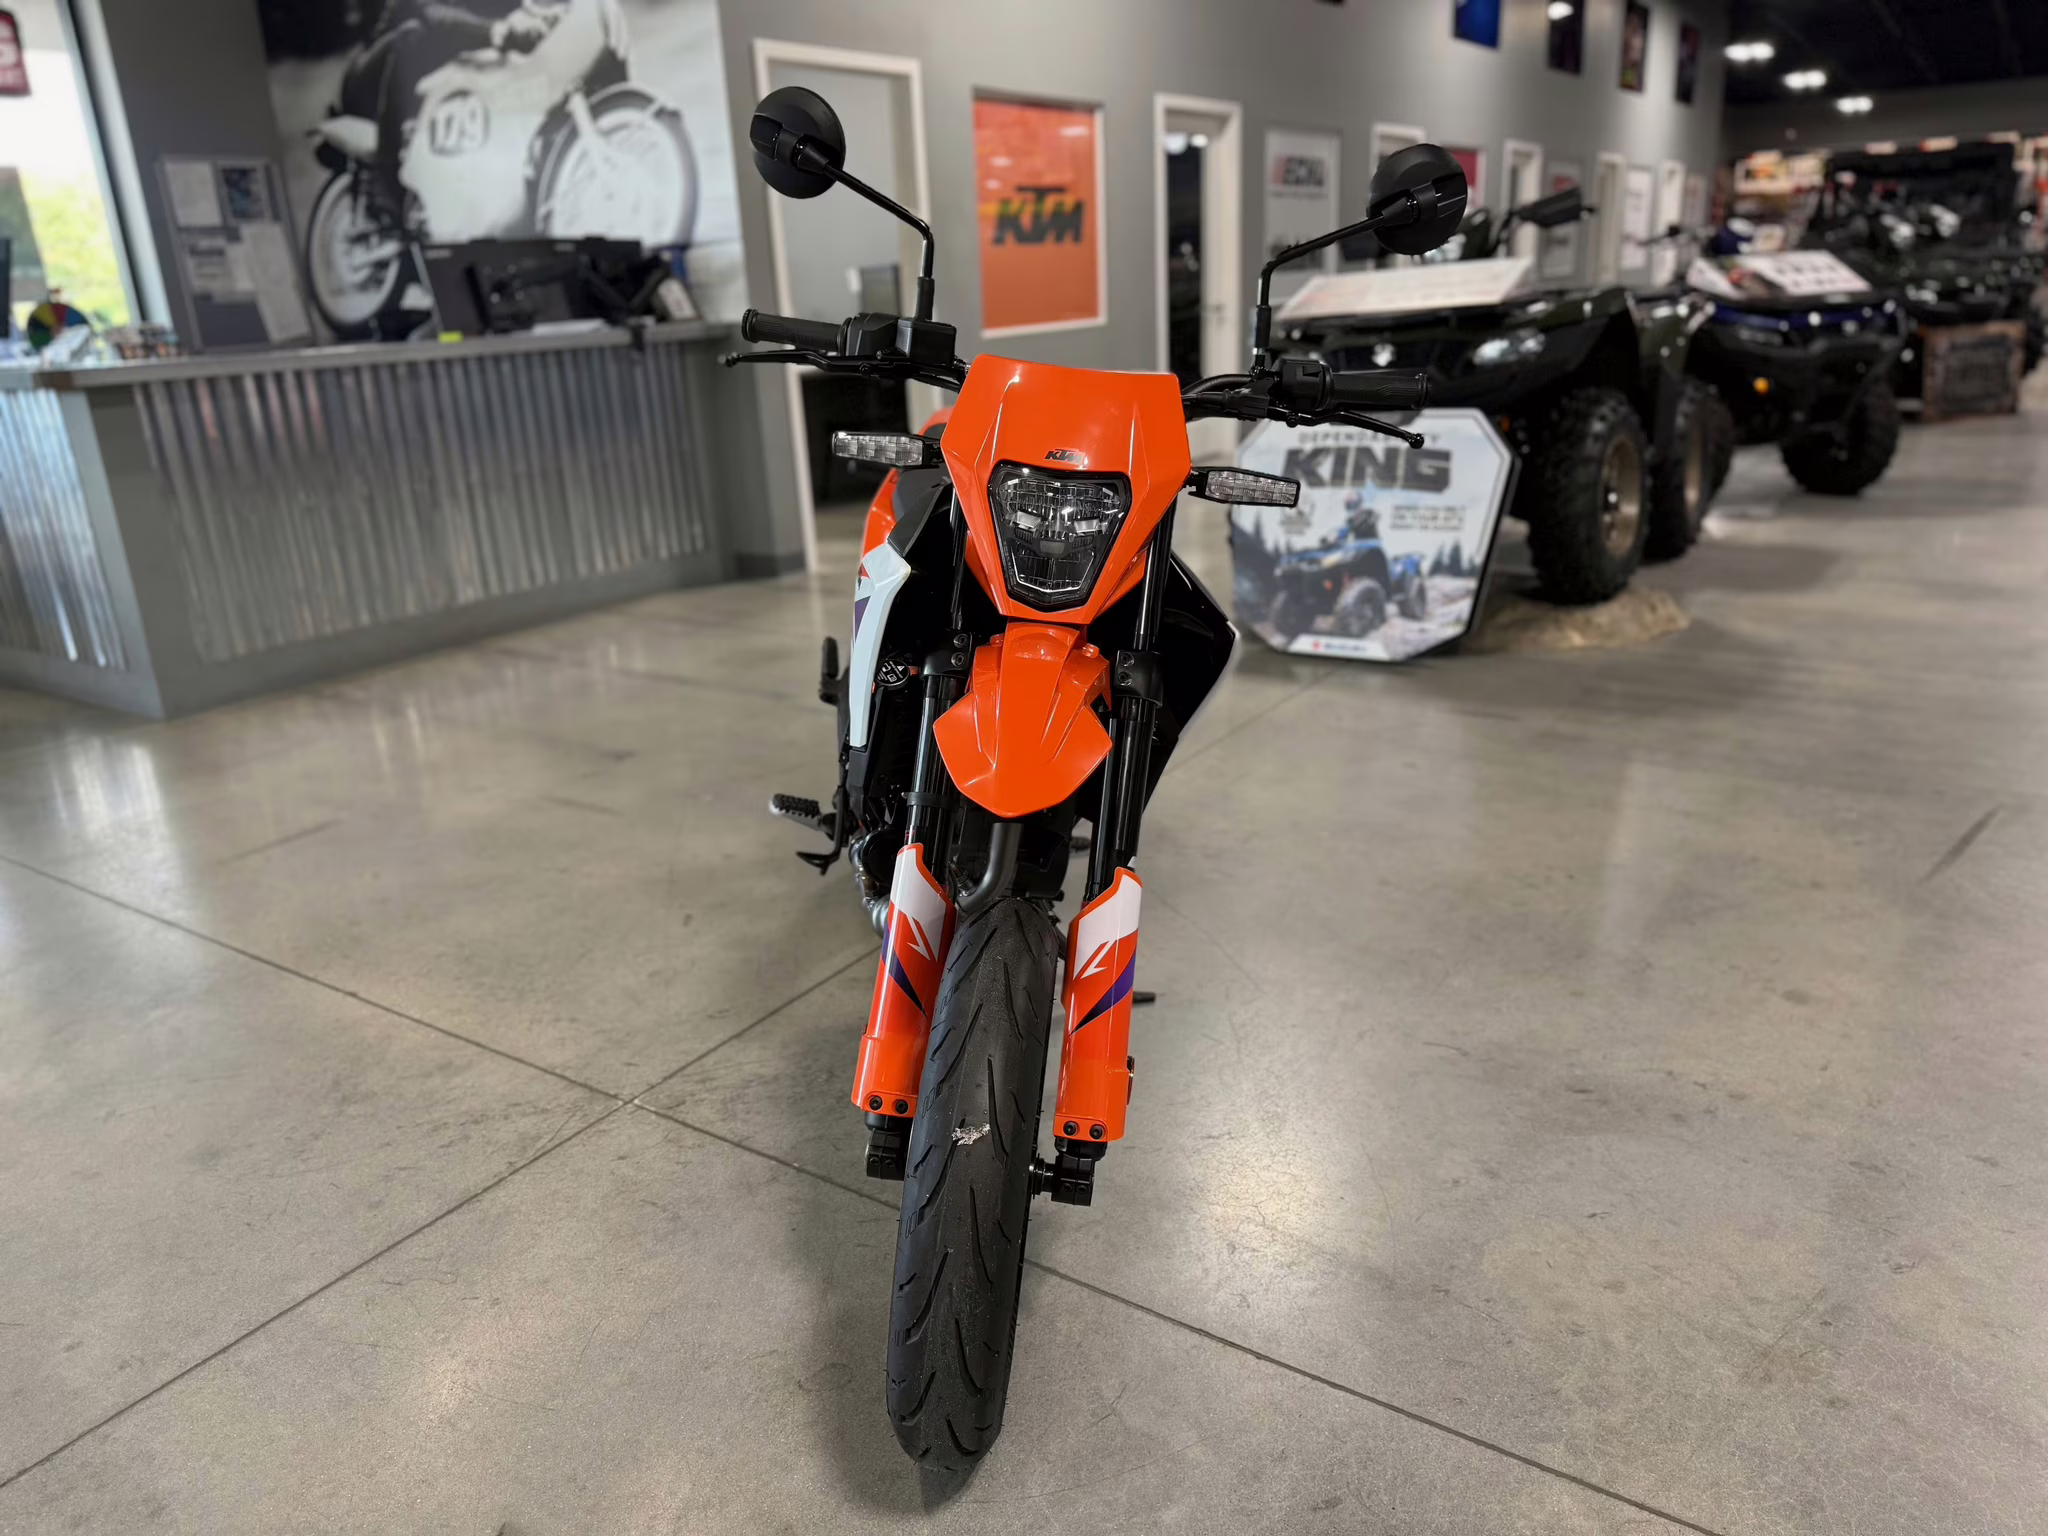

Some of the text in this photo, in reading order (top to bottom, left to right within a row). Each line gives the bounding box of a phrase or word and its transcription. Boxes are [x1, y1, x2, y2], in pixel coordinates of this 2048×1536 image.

[993, 185, 1086, 245] KTM
[1044, 448, 1085, 465] KTM
[1282, 446, 1451, 493] KING
